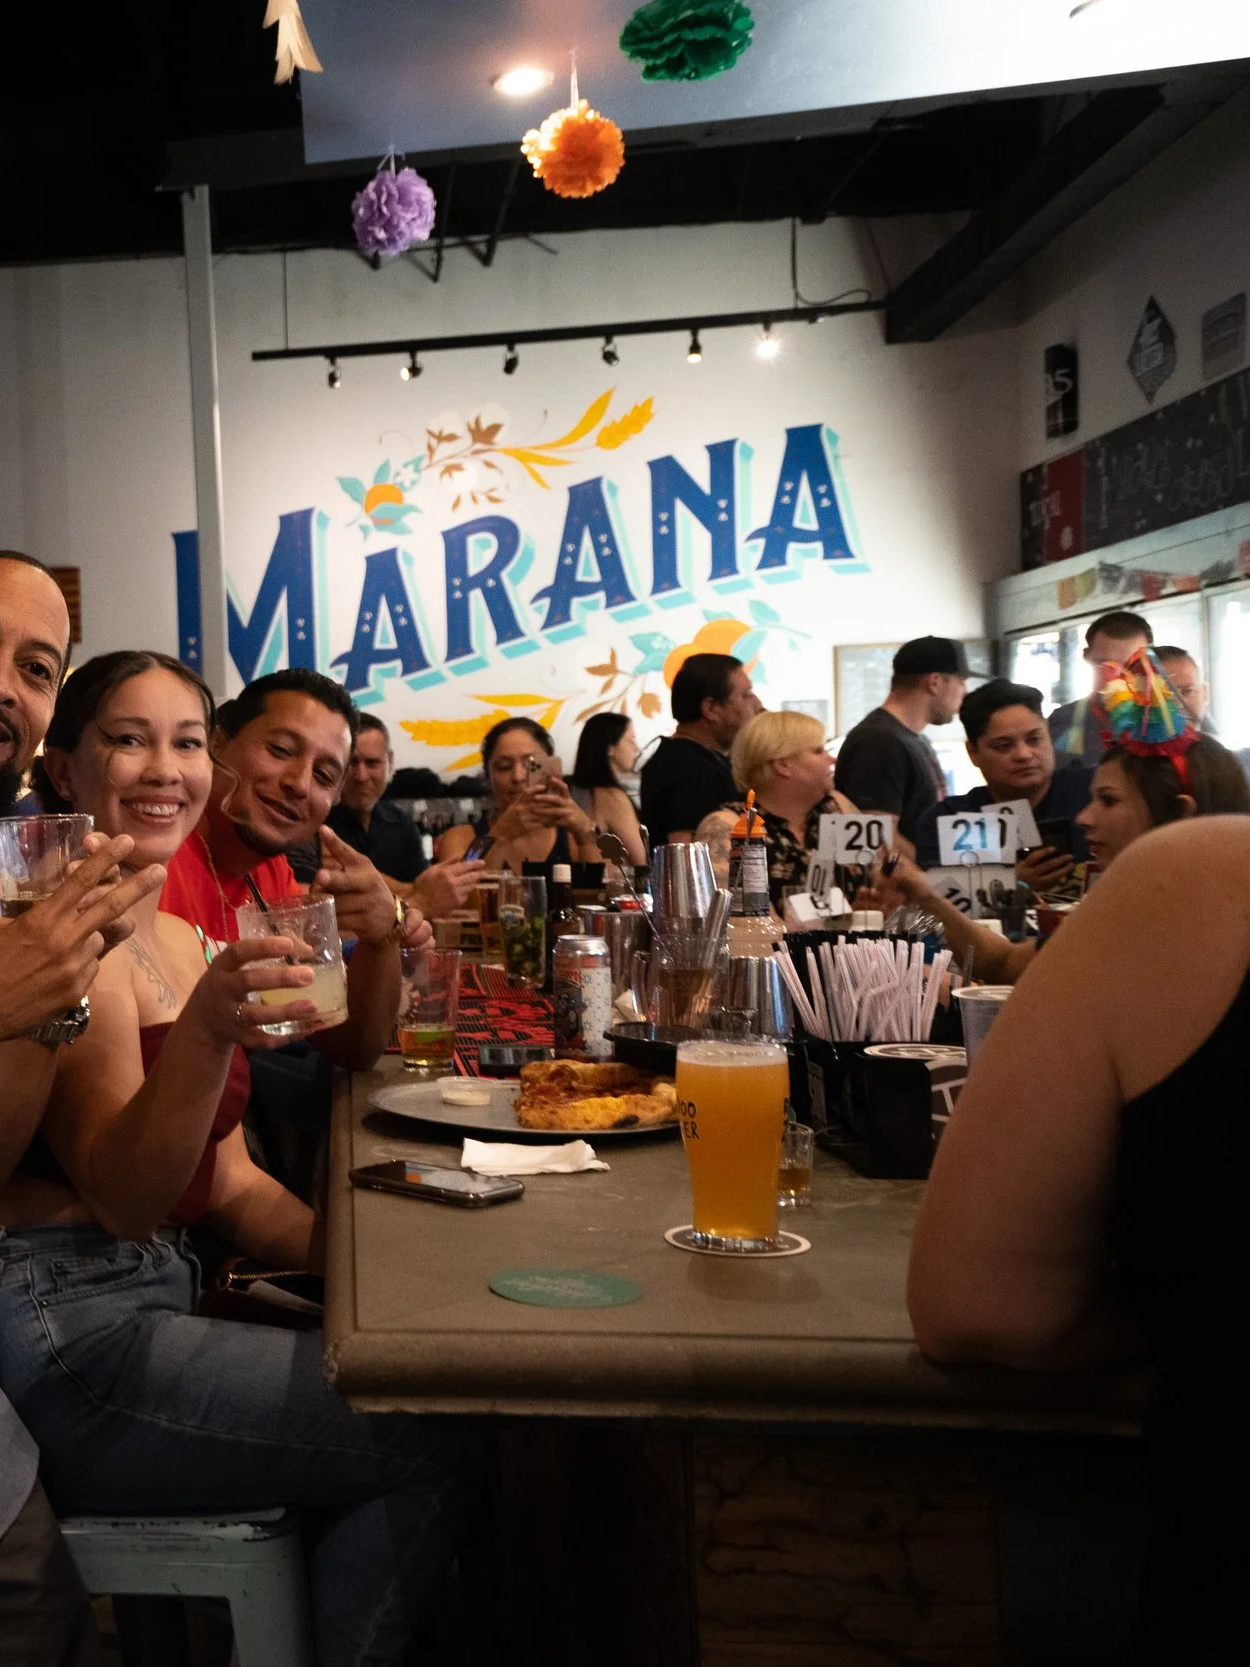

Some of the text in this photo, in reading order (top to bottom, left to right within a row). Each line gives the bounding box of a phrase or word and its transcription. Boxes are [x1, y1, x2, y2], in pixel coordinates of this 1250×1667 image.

[171, 423, 858, 694] MARANA
[844, 820, 883, 851] 20
[952, 818, 988, 851] 21
